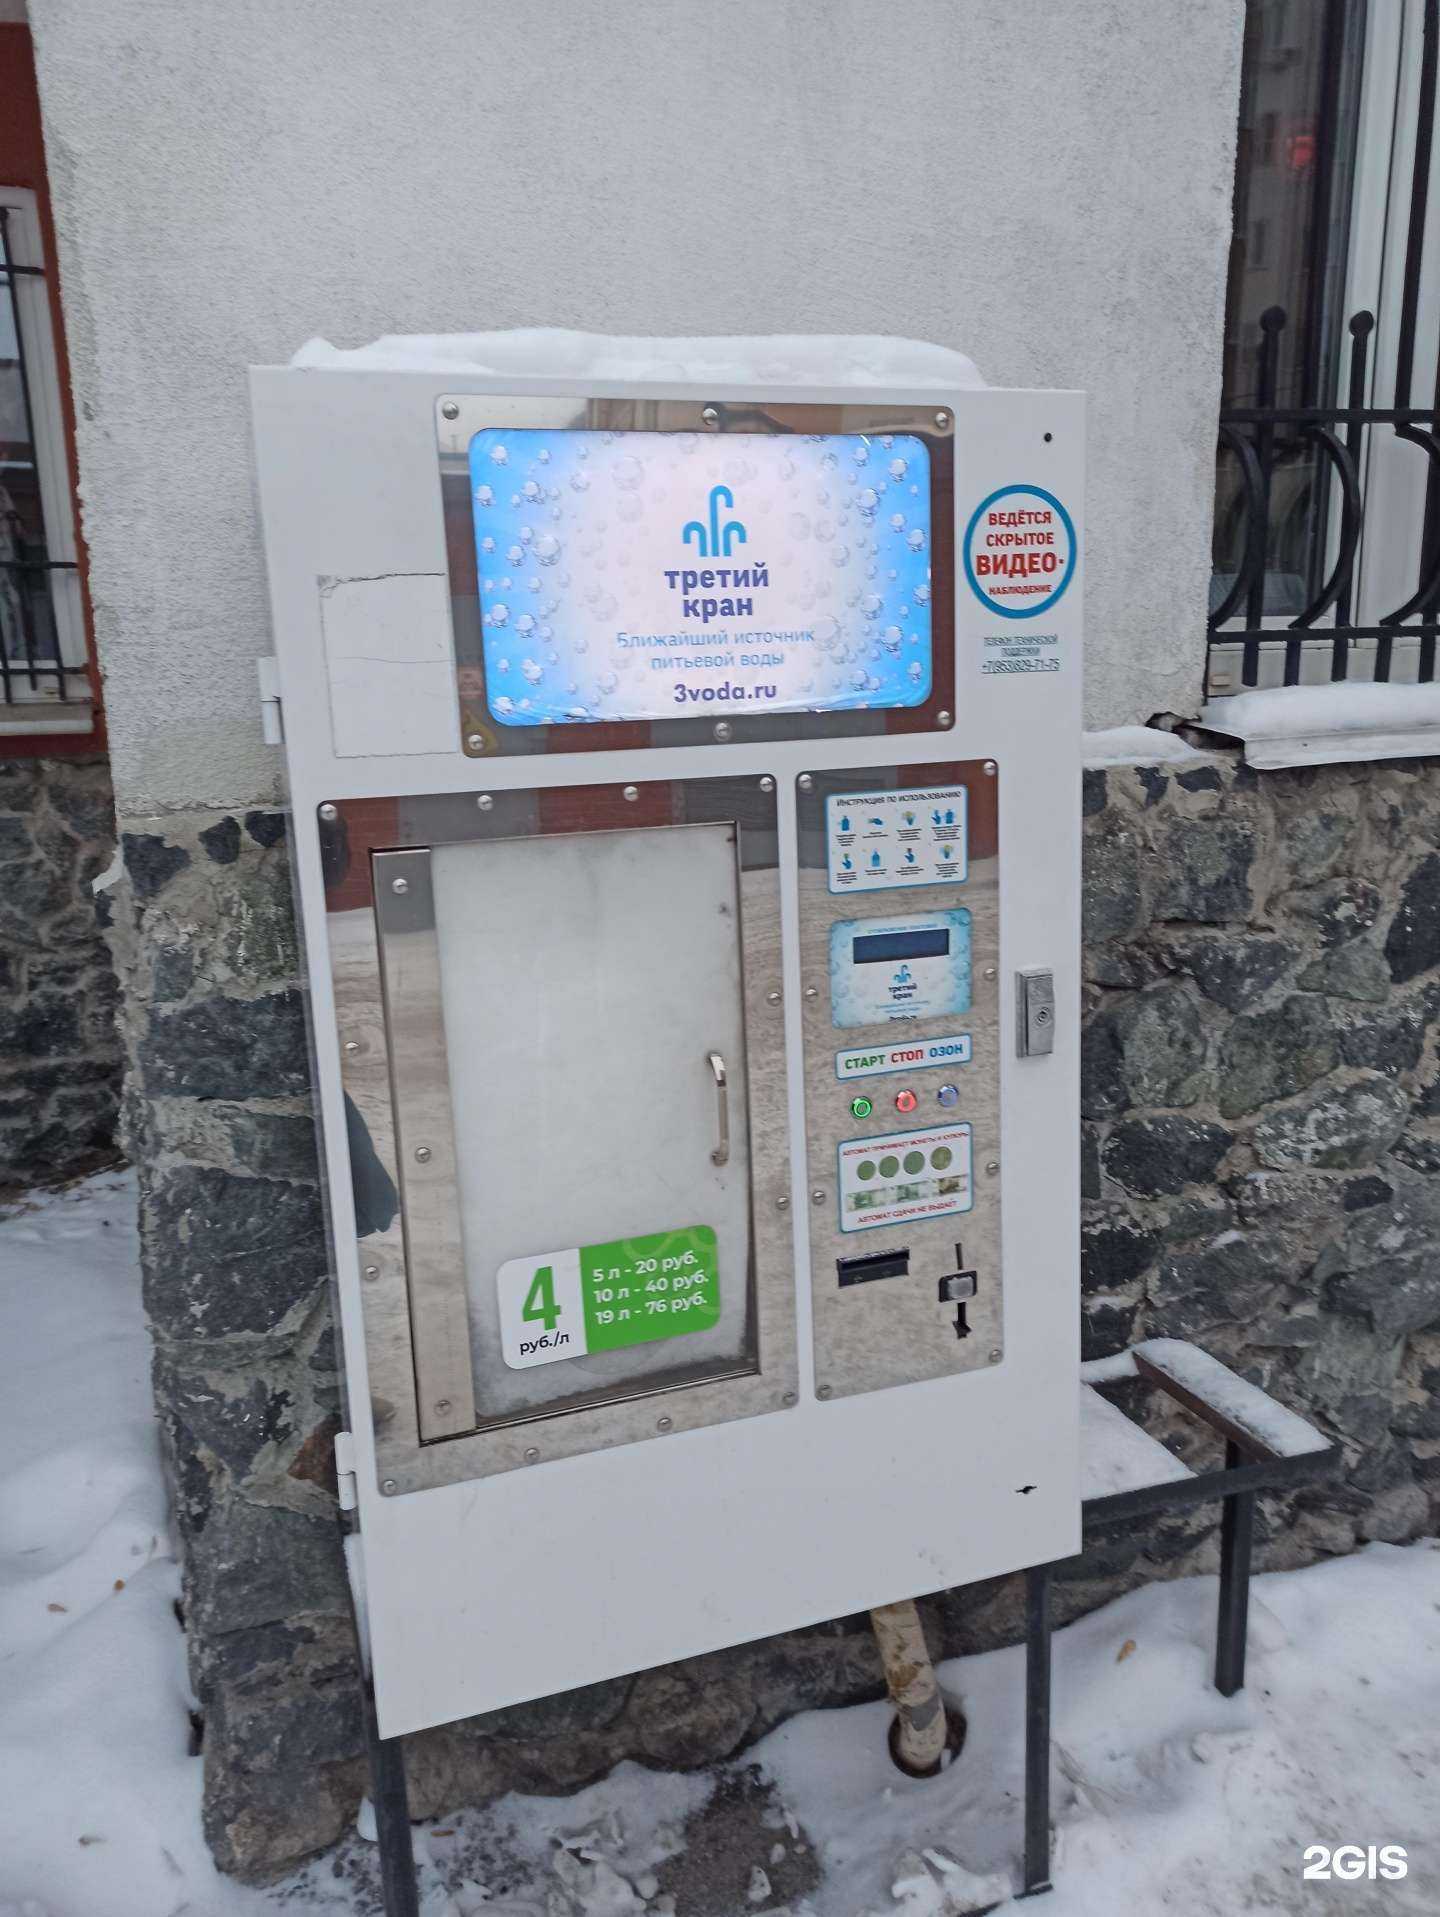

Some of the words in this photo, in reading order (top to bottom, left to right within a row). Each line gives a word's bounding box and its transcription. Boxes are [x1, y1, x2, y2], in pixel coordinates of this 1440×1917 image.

[988, 510, 1052, 527] ВЕДЁТСЯ
[986, 532, 1054, 547] СКРЫТОЕ
[664, 562, 769, 595] третий
[989, 584, 1052, 595] НАБЛЮДЕНИЕ
[682, 595, 754, 623] кран
[615, 629, 729, 649] Ближайший
[733, 629, 816, 647] источник
[650, 650, 736, 669] питьевой
[740, 652, 784, 668] воды
[673, 681, 777, 703] 3voda.ru
[844, 1054, 886, 1070] СТАРТ
[891, 1049, 924, 1064] СТОП
[929, 1043, 963, 1058] ОЗОН
[592, 1268, 604, 1283] 5
[608, 1267, 620, 1279] л
[635, 1258, 657, 1275] 20
[661, 1250, 698, 1273] руб.
[522, 1265, 562, 1331] 4
[593, 1288, 613, 1304] 10
[616, 1286, 629, 1299] л
[645, 1277, 668, 1294] 40
[672, 1270, 709, 1293] руб.
[595, 1309, 614, 1325] 19
[617, 1308, 630, 1321] л
[645, 1299, 668, 1315] 76
[671, 1291, 708, 1314] руб.
[519, 1331, 569, 1356] руб./л
